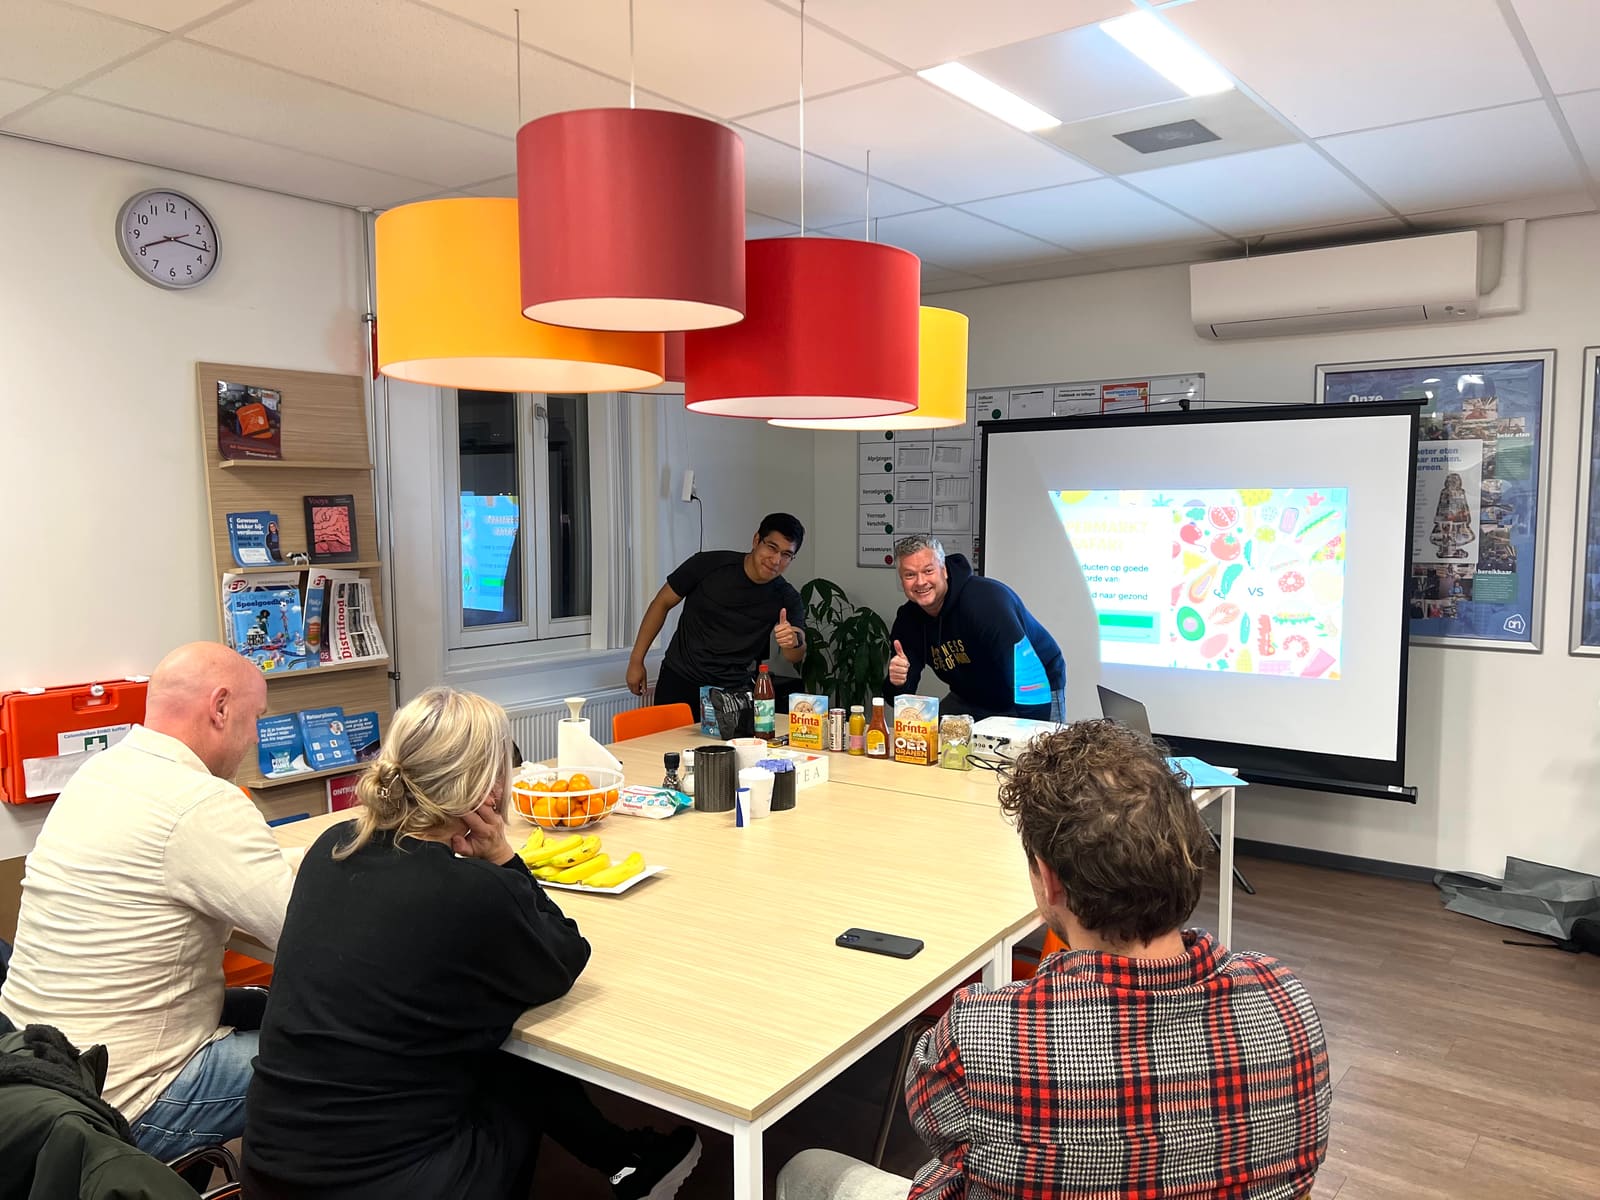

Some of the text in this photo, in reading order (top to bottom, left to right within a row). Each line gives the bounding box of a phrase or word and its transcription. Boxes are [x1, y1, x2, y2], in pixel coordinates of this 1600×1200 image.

[150, 204, 158, 216] 11
[166, 202, 176, 214] 12
[138, 214, 148, 225] 10
[184, 210, 188, 220] 1
[133, 229, 140, 239] 9
[195, 224, 202, 235] 2
[202, 240, 208, 250] 3
[140, 246, 147, 256] 8
[196, 254, 202, 264] 4
[152, 259, 160, 270] 7
[170, 268, 176, 277] 6
[186, 265, 192, 275] 5
[1066, 521, 1148, 534] PERMARKT
[1081, 564, 1109, 572] ducten
[1123, 564, 1148, 573] goede
[1118, 592, 1148, 600] gezond
[1248, 587, 1264, 596] VS
[337, 600, 352, 658] Distrifood
[790, 713, 820, 727] Brinta
[896, 721, 928, 734] Brinta
[896, 737, 928, 752] OER
[896, 748, 928, 757] GRANEN
[797, 766, 820, 784] TEA
